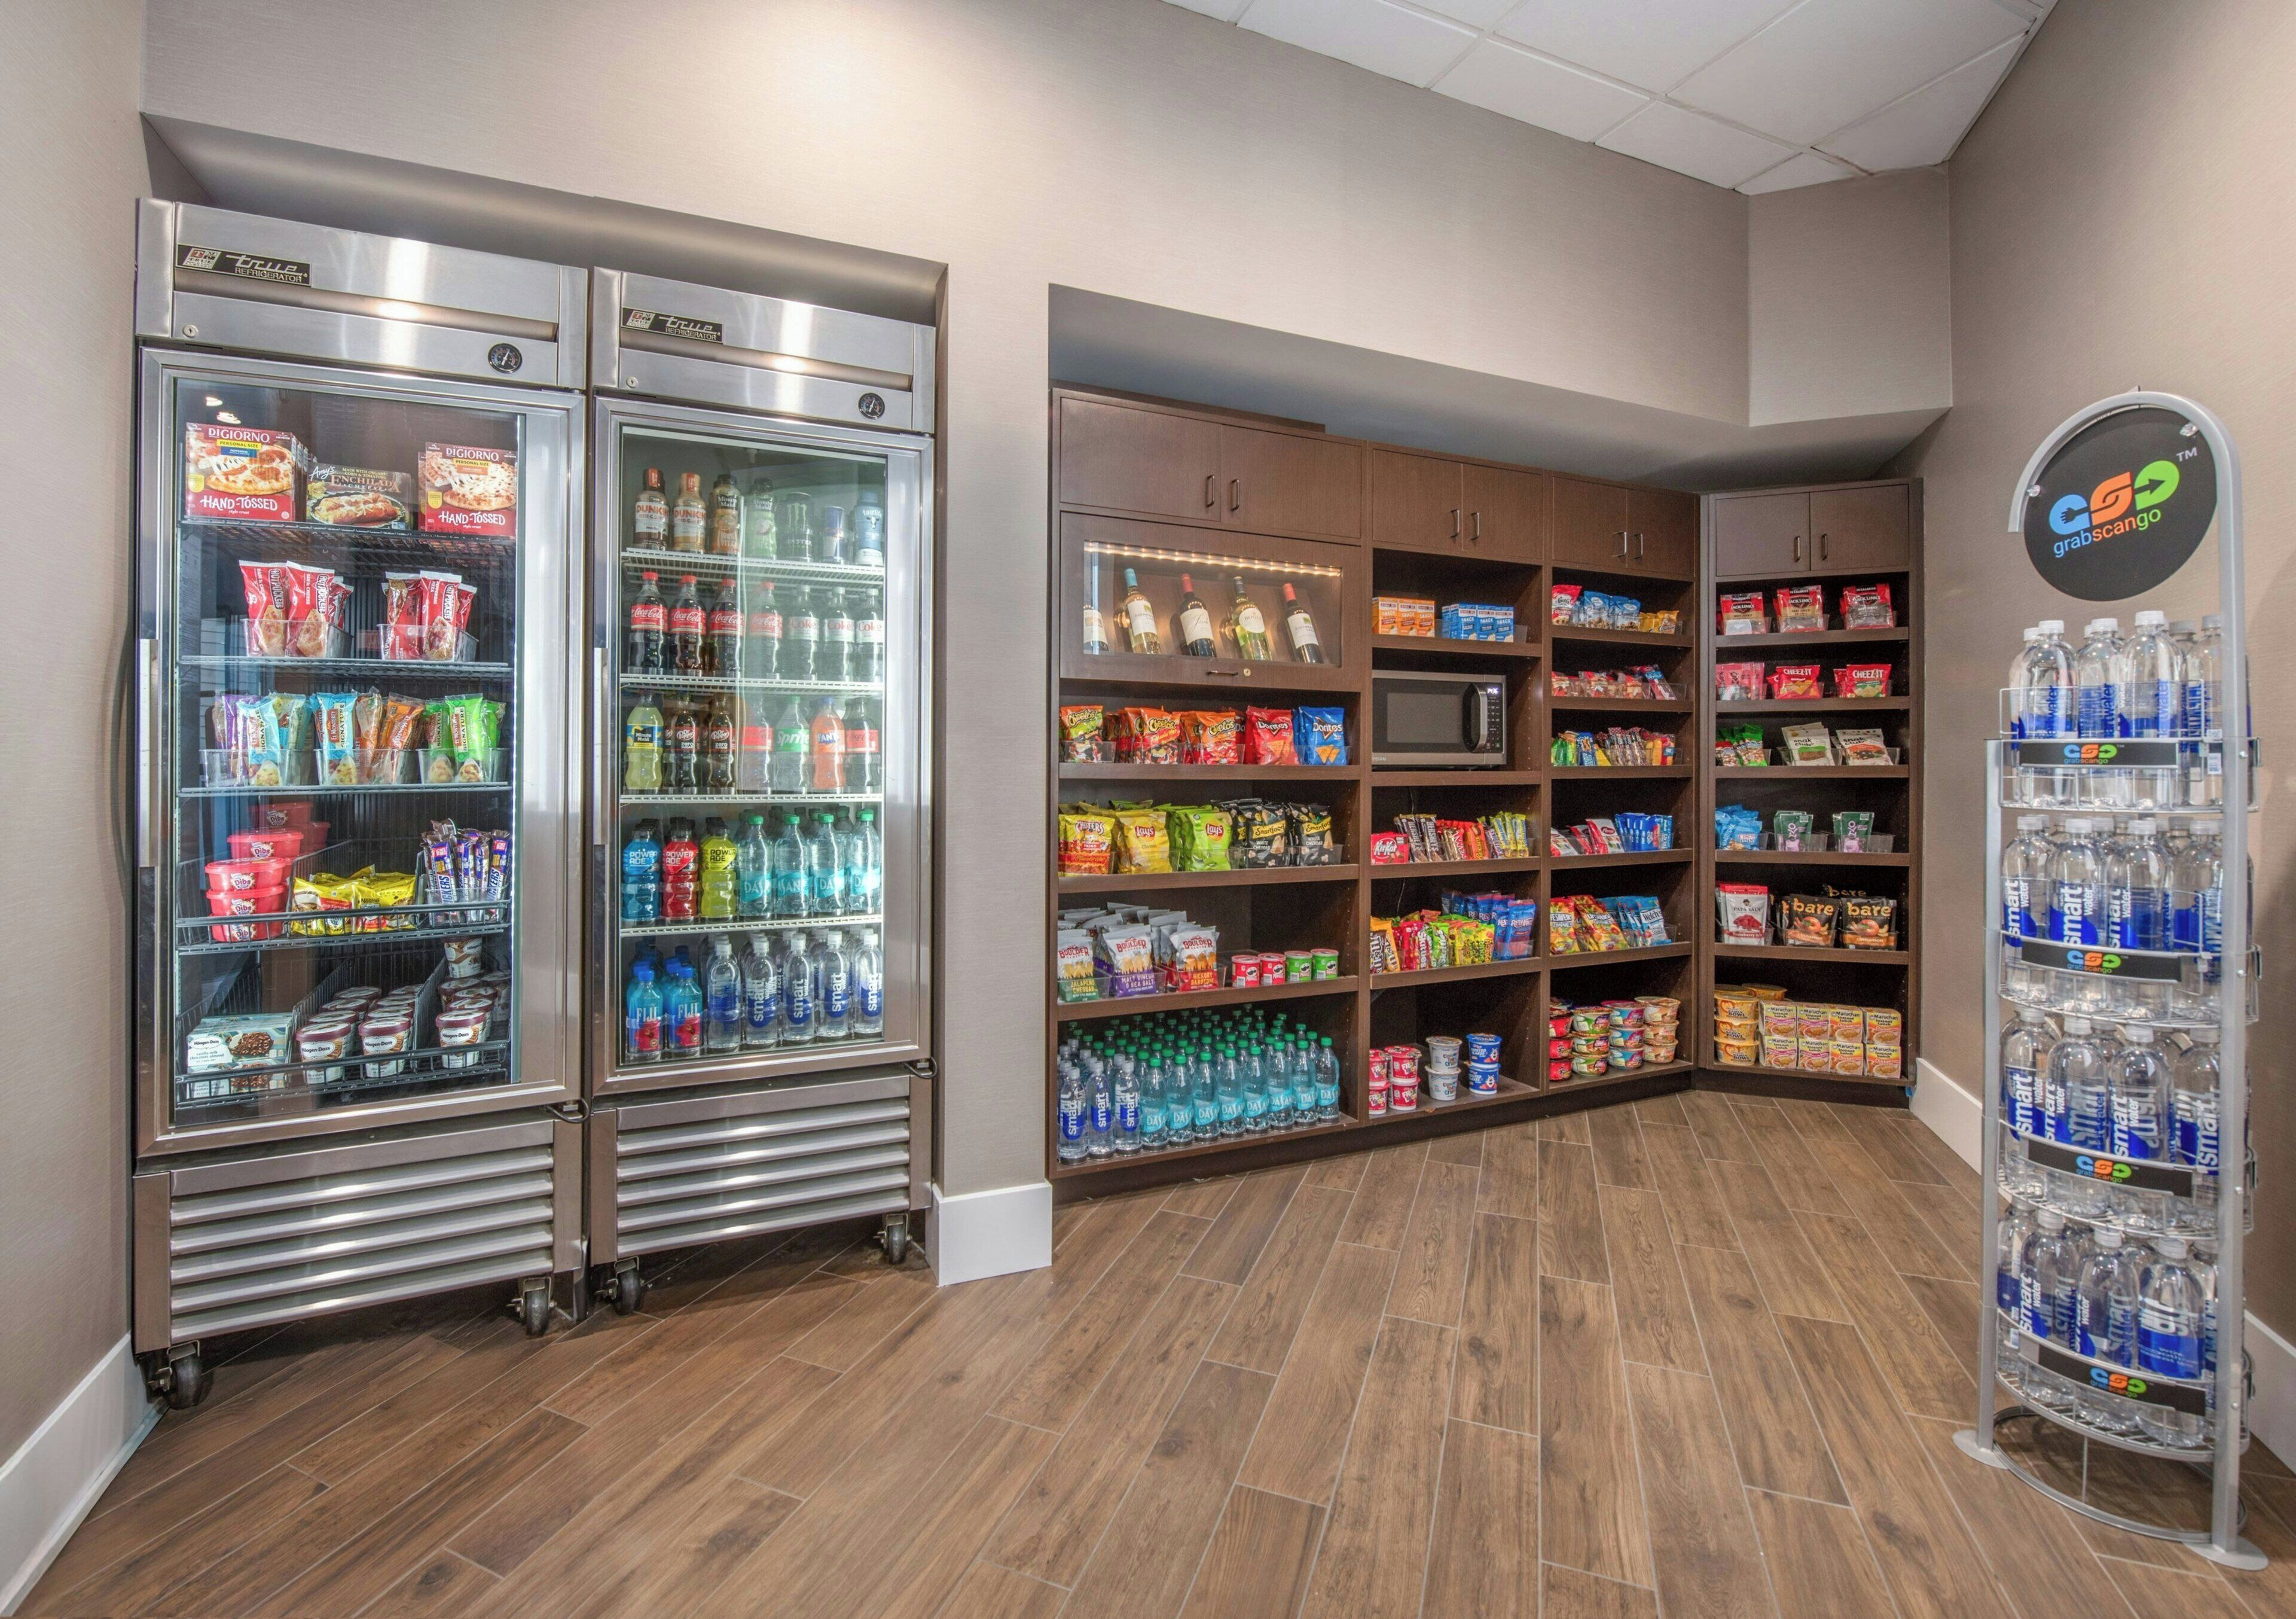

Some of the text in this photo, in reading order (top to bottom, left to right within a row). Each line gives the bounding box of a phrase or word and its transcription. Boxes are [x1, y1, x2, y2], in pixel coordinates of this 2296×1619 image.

[225, 254, 303, 276] true
[235, 267, 302, 283] REFRIGERATOR
[658, 315, 720, 335] true
[665, 327, 717, 341] REFRIGERATOR
[208, 427, 271, 443] DIGIORNO
[446, 447, 500, 462] DIGIORNO
[2176, 447, 2197, 462] TM
[310, 466, 336, 481] Amy's
[330, 474, 401, 493] ENCHILADA
[348, 483, 384, 492] CHEESE
[200, 495, 278, 511] HAND-TOSSED
[438, 511, 506, 526] HAND-TOSSED
[2053, 509, 2161, 558] grabscango
[1067, 708, 1098, 727] Cheetos
[1148, 717, 1176, 731] Cheetos
[1258, 719, 1289, 731] Doritos
[1208, 719, 1235, 737] Cheetos
[1312, 721, 1342, 733] Doritos
[777, 731, 809, 746] Sprite
[2063, 756, 2109, 766] grabscango
[270, 814, 285, 822] Dibs
[1136, 826, 1155, 837] Lay's
[1207, 824, 1224, 836] Lay's
[1255, 823, 1286, 836] Smartfood
[234, 878, 251, 886] Dibs
[1829, 885, 1867, 897] bare
[2019, 881, 2029, 908] water
[1793, 898, 1834, 916] bare
[1847, 901, 1892, 916] bare
[2005, 880, 2021, 939] smart
[2083, 887, 2093, 916] water
[2121, 889, 2131, 918] water
[1643, 910, 1662, 921] Welch's
[2063, 886, 2083, 945] smart
[2108, 888, 2121, 949] smart
[1116, 938, 1147, 953] BOULDER
[1183, 938, 1213, 950] BOULDER
[1058, 947, 1089, 959] BOULDER
[2067, 962, 2113, 974] grabscango
[753, 978, 764, 1022] smart
[793, 979, 804, 1018] smart
[832, 973, 842, 1011] smart
[868, 973, 878, 1011] smart
[636, 1006, 658, 1022] FIJI
[678, 1002, 700, 1018] FIJI
[2034, 1077, 2043, 1103] water
[2015, 1074, 2032, 1135] smart
[2056, 1086, 2065, 1114] water
[1067, 1100, 1077, 1136] smart
[1097, 1093, 1107, 1127] smart
[1126, 1093, 1135, 1127] smart
[2129, 1098, 2139, 1127] water
[2111, 1094, 2130, 1157] smart
[2076, 1167, 2123, 1184] grabscango
[2033, 1279, 2042, 1307] water
[2019, 1273, 2033, 1333] smart
[2081, 1295, 2090, 1325] water
